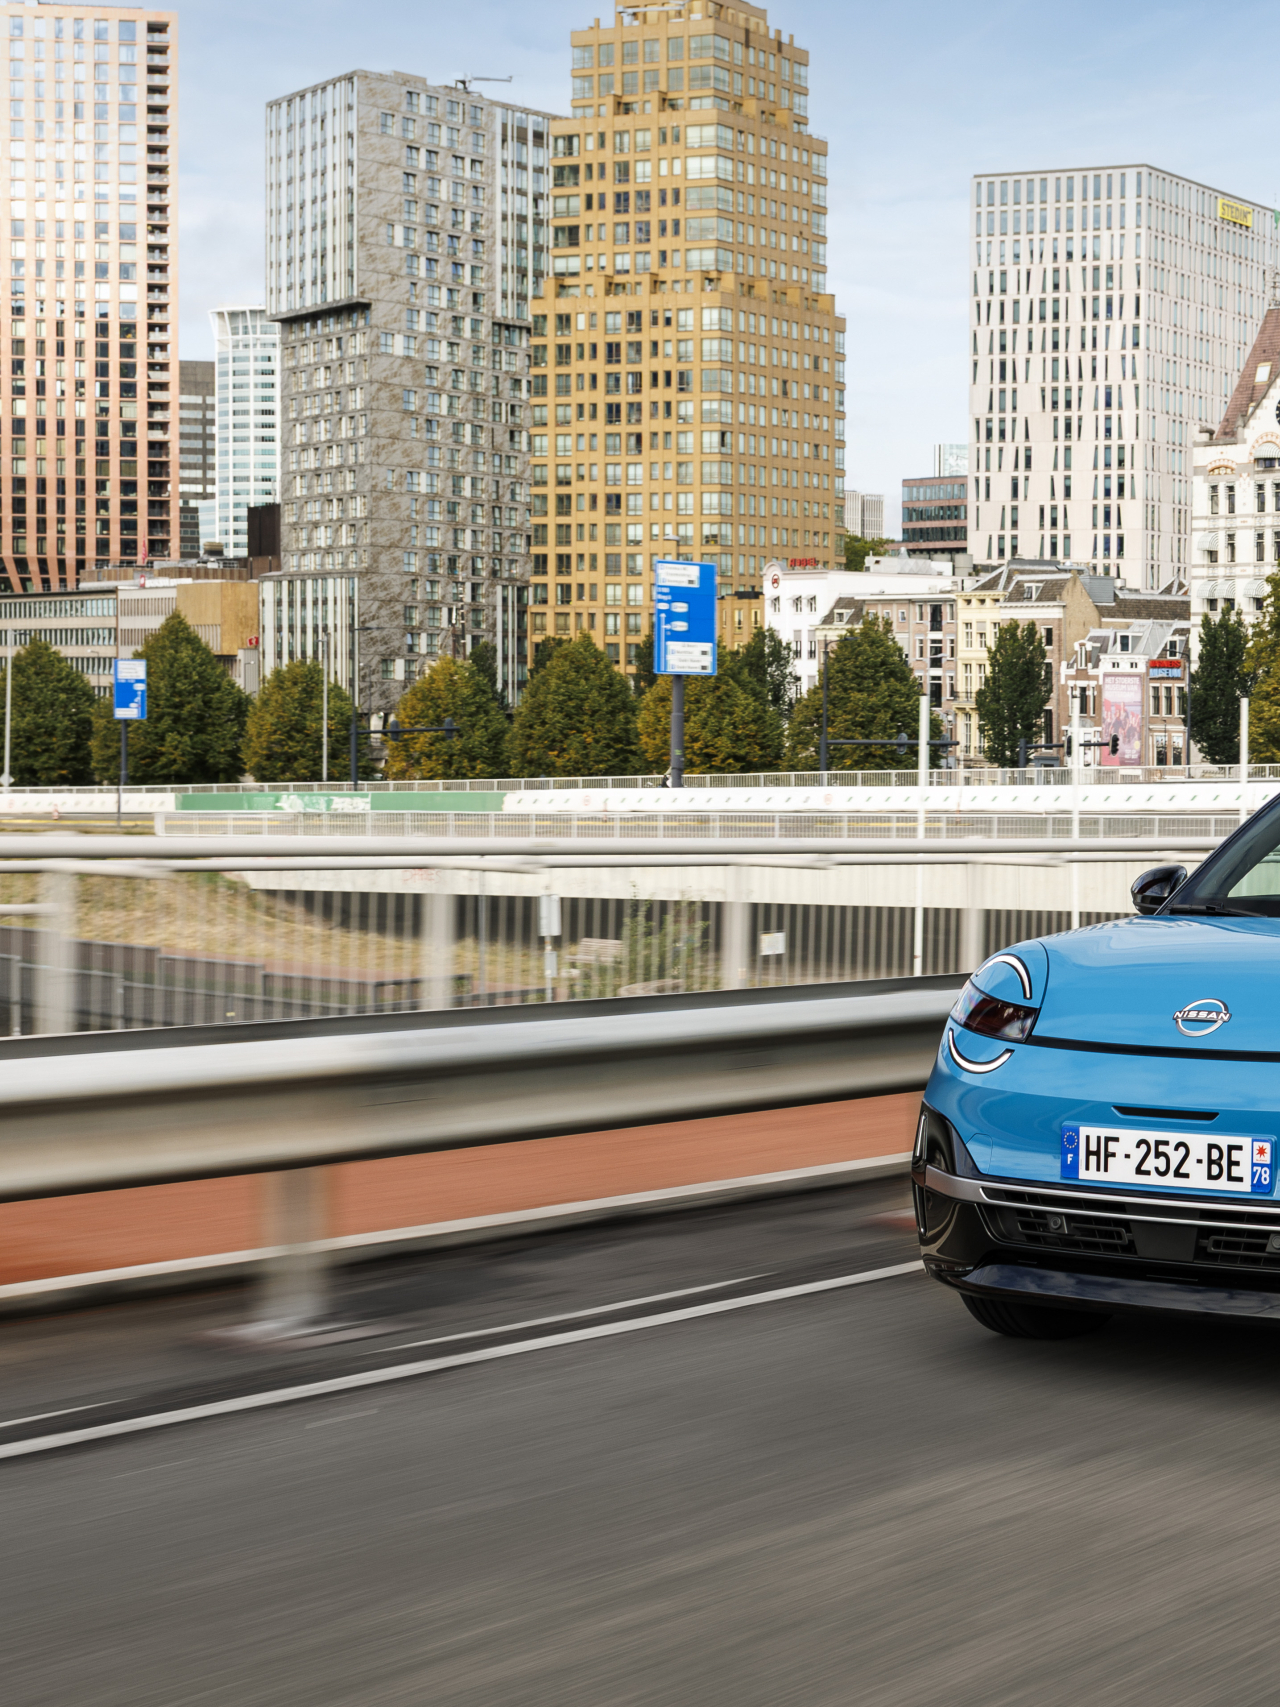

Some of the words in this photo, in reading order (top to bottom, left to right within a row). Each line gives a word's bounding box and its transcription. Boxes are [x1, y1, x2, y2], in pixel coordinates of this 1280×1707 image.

[1173, 1010, 1230, 1021] NISSAN
[1066, 1153, 1074, 1165] F
[1085, 1134, 1244, 1183] HF-252-BE
[1252, 1165, 1270, 1185] 78
